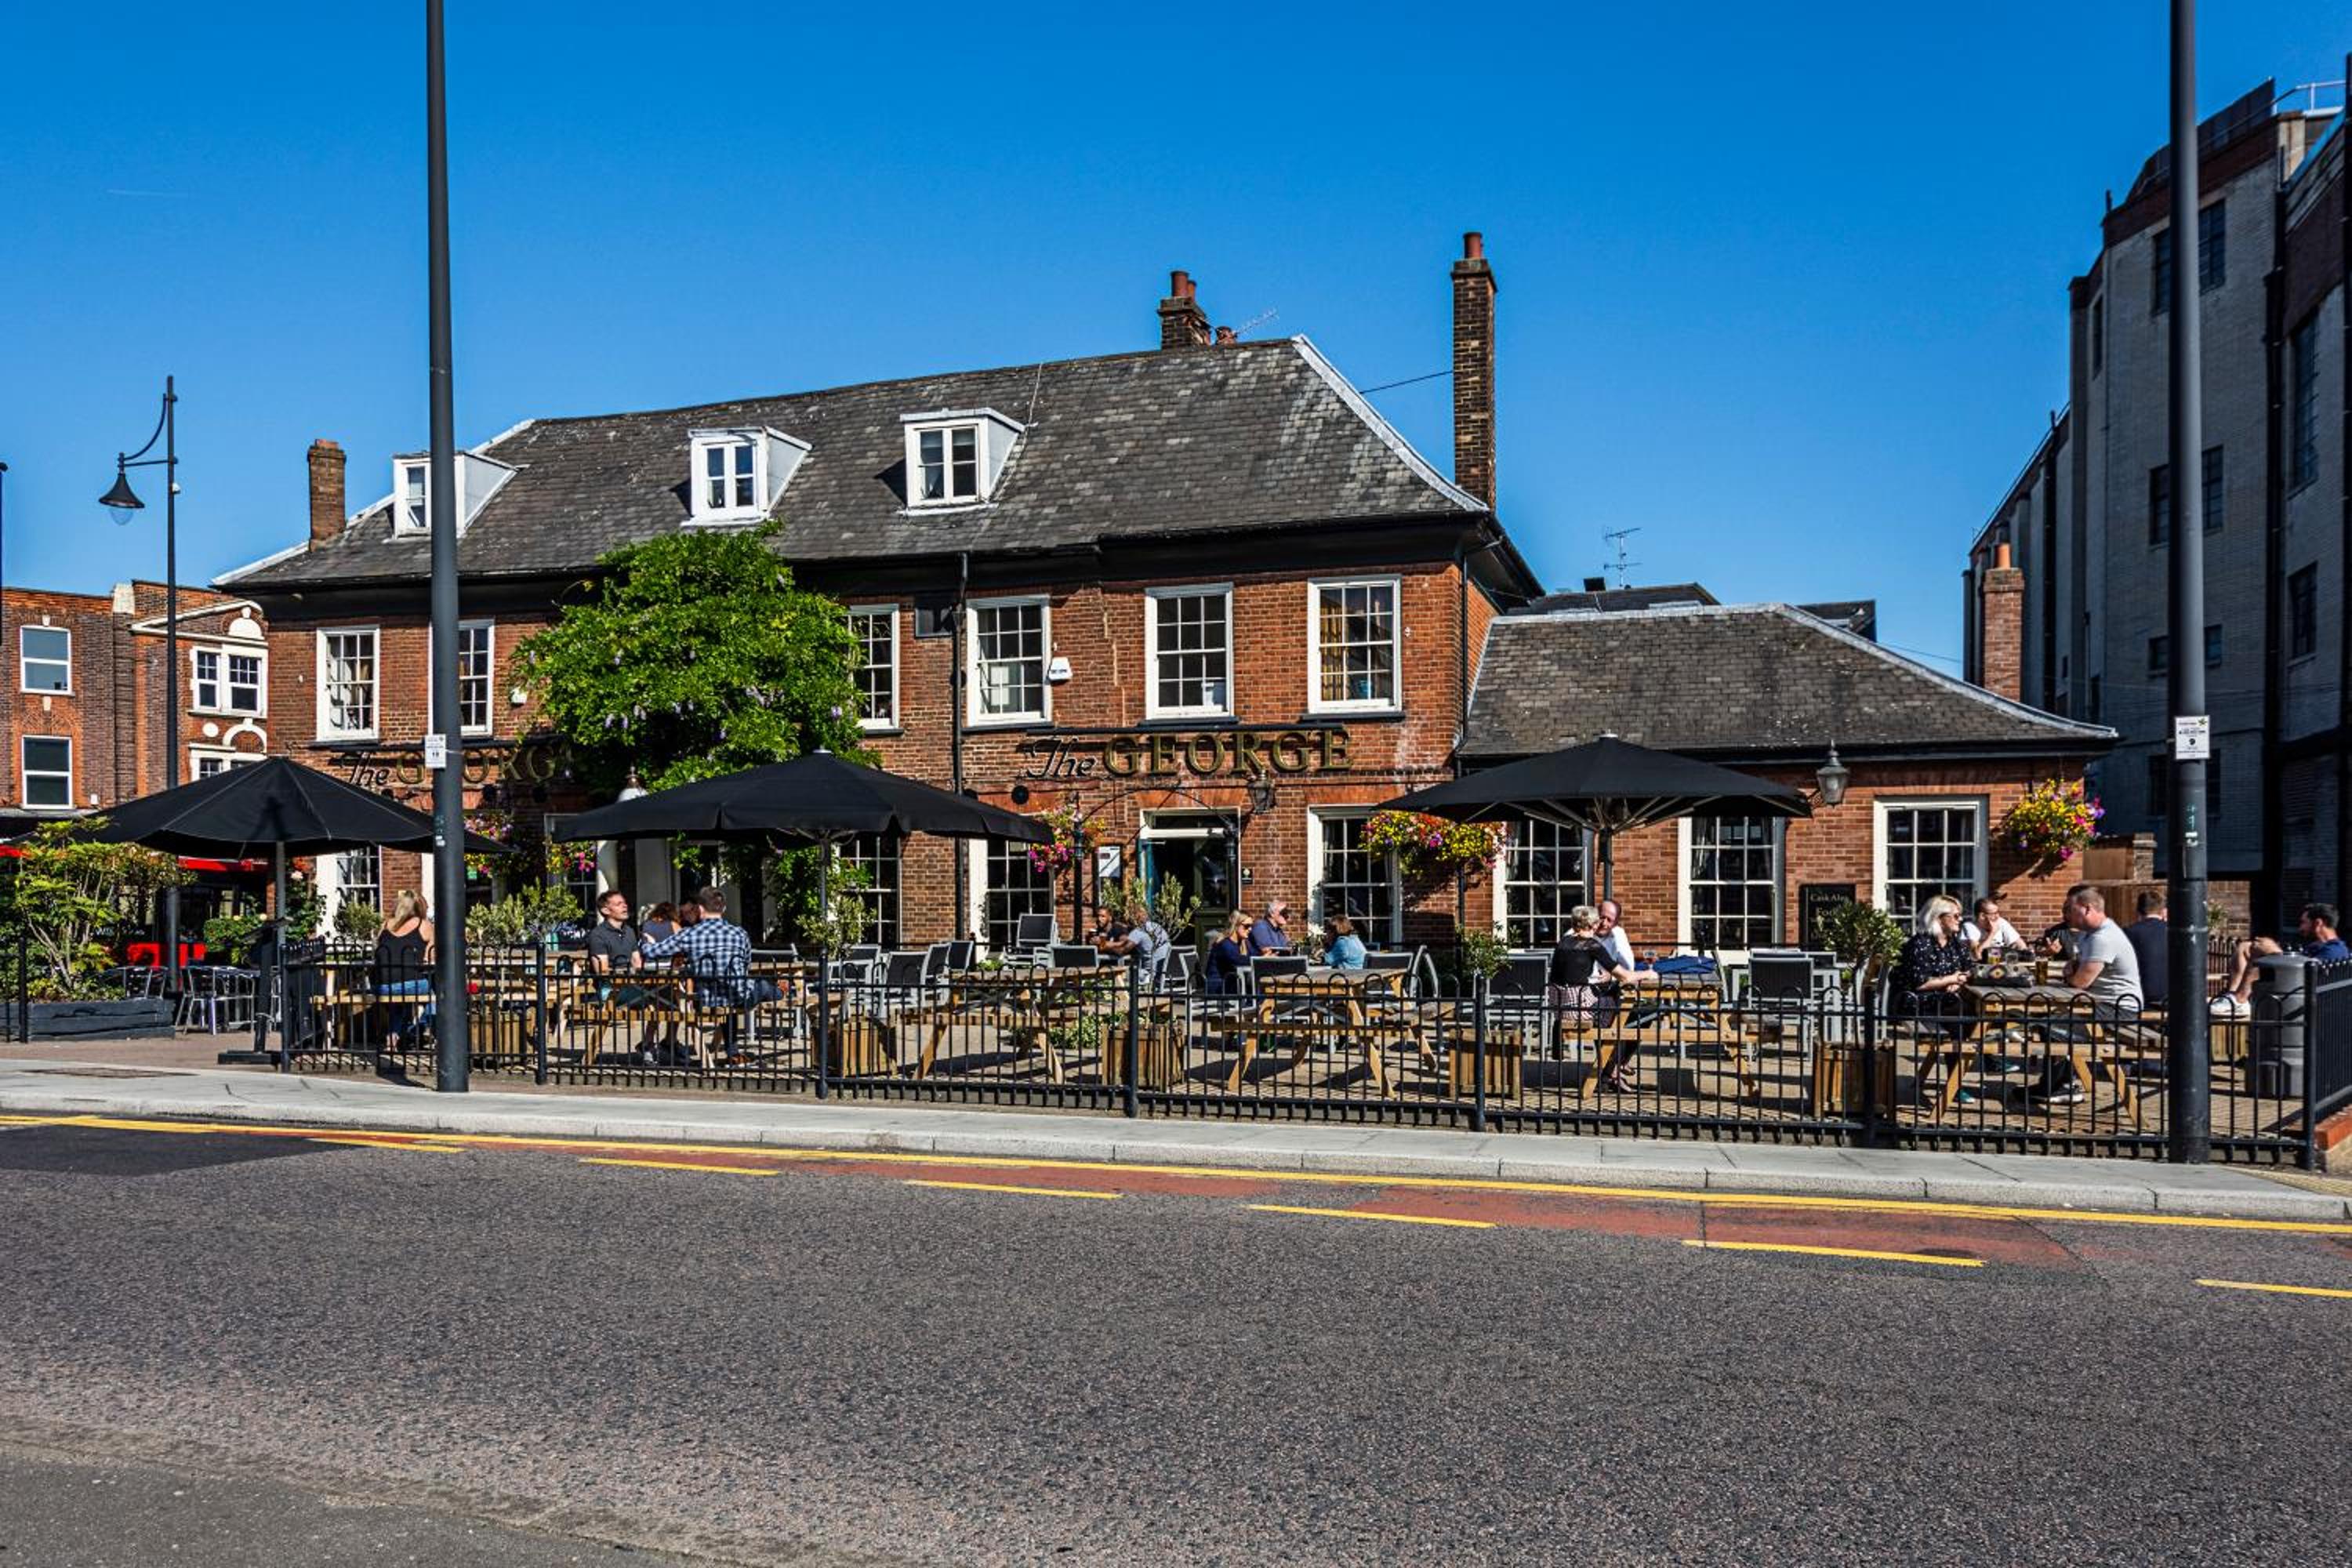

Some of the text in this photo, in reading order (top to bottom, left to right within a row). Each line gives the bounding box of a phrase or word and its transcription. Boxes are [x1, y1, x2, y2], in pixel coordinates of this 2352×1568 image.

[396, 746, 574, 785] GORG
[1024, 729, 1354, 779] The GEORGE
